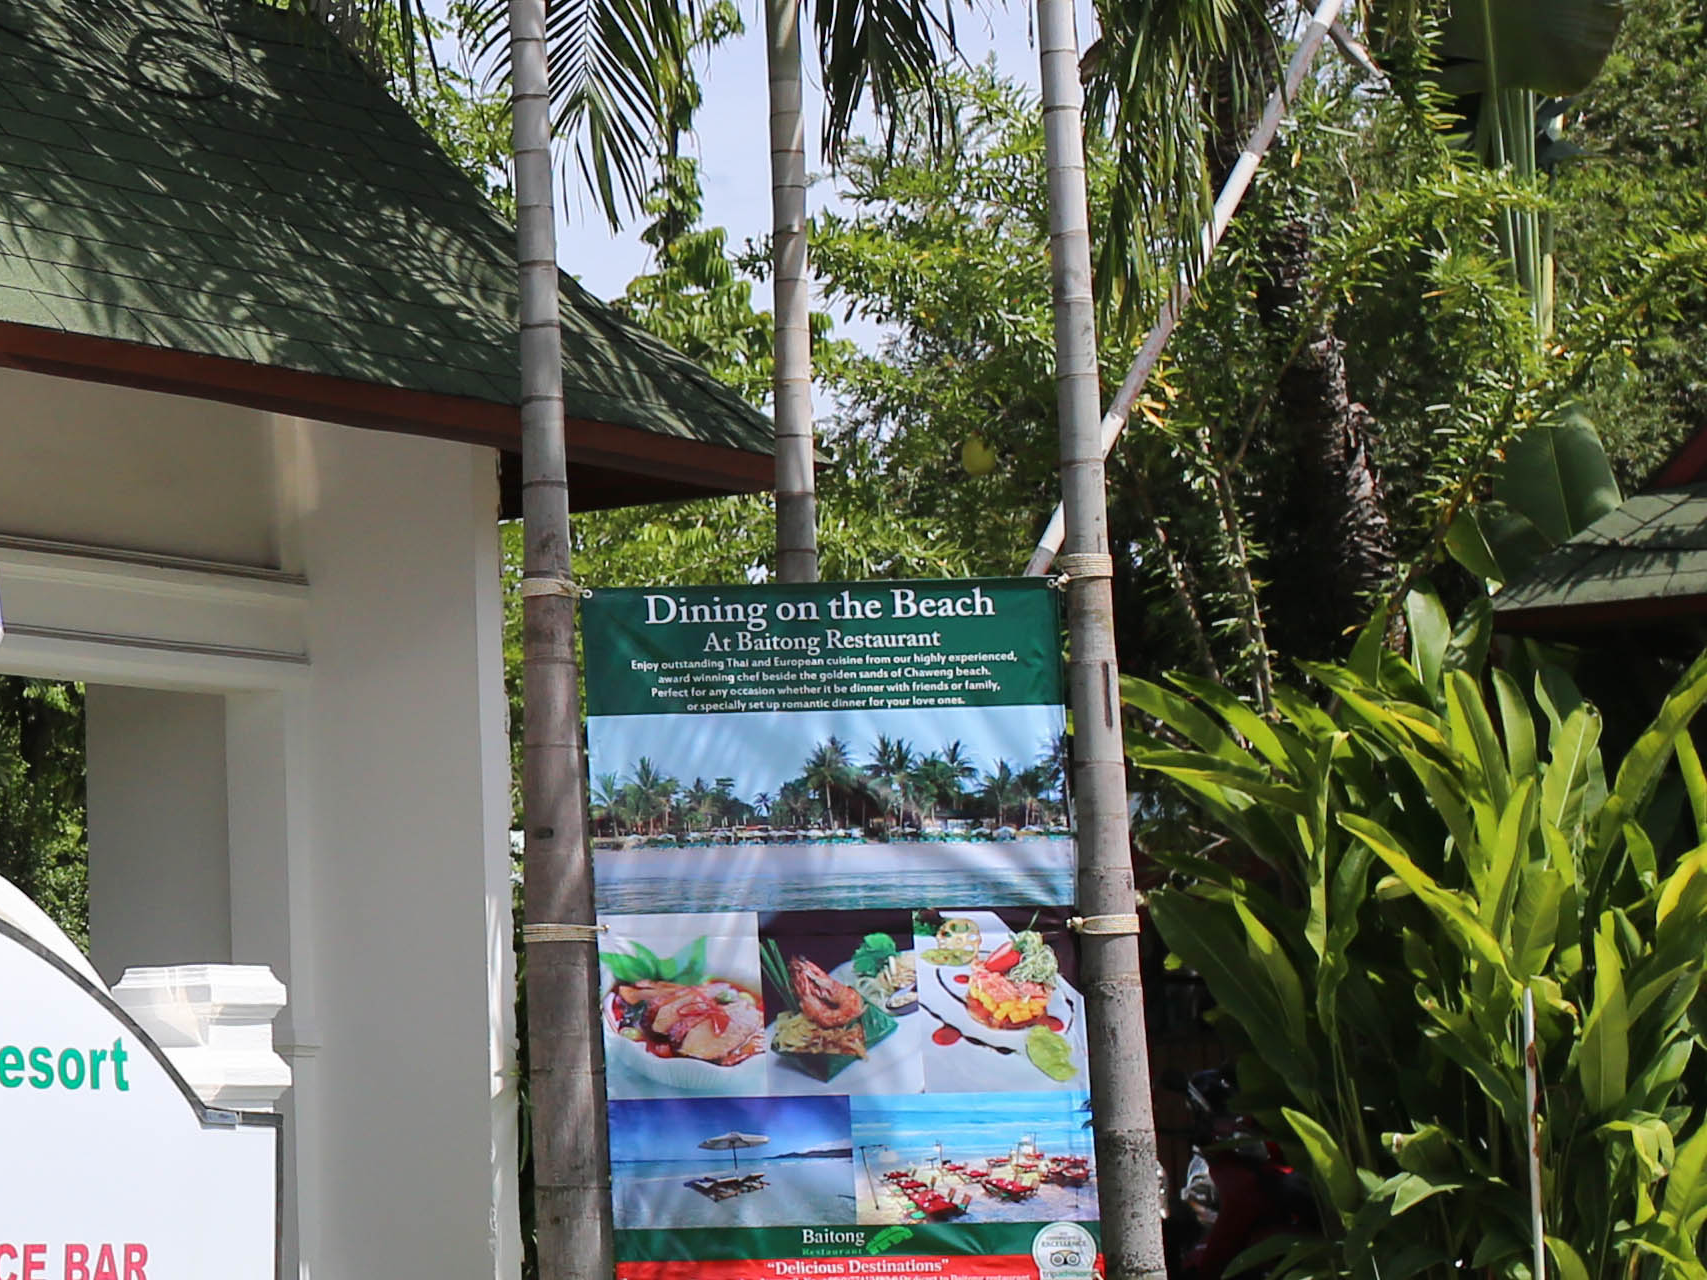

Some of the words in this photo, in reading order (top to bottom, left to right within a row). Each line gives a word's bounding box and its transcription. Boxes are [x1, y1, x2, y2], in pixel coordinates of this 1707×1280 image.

[643, 594, 768, 631] Dining
[776, 602, 820, 621] on
[827, 590, 883, 619] the
[890, 587, 996, 618] Beach
[703, 632, 731, 652] At
[737, 628, 821, 655] Baitong
[826, 629, 941, 649] Restaurant
[631, 659, 659, 672] Enjoy
[661, 659, 724, 671] outstanding
[727, 658, 749, 667] Thai
[751, 657, 771, 667] and
[773, 656, 824, 668] European
[826, 655, 864, 665] cuisine
[865, 654, 891, 664] from
[893, 656, 911, 664] our
[913, 652, 947, 666] highly
[948, 650, 1018, 664] experienced,
[658, 674, 690, 684] award
[693, 673, 735, 685] winning
[737, 671, 759, 682] chef
[762, 671, 797, 681] beside
[799, 670, 817, 680] the
[819, 669, 857, 682] golden
[858, 668, 889, 679] sands
[890, 667, 902, 678] of
[903, 667, 954, 679] Chaweng
[955, 665, 991, 676] beach.
[651, 687, 688, 697] Perfect
[691, 687, 706, 697] for
[709, 689, 728, 698] any
[729, 687, 775, 696] occasion
[777, 685, 821, 694] whether
[823, 685, 831, 693] it
[833, 684, 848, 693] be
[849, 683, 885, 693] dinner
[885, 681, 910, 692] with
[912, 680, 949, 691] friends
[950, 683, 963, 691] or
[964, 679, 1001, 692] family,
[687, 703, 698, 711] or
[700, 700, 746, 713] specially
[748, 701, 764, 710] set
[766, 702, 780, 711] up
[782, 699, 829, 709] romantic
[832, 698, 867, 707] dinner
[869, 696, 884, 706] for
[887, 698, 910, 709] your
[912, 696, 935, 705] love
[937, 697, 966, 705] ones.
[802, 1228, 865, 1247] Baitong
